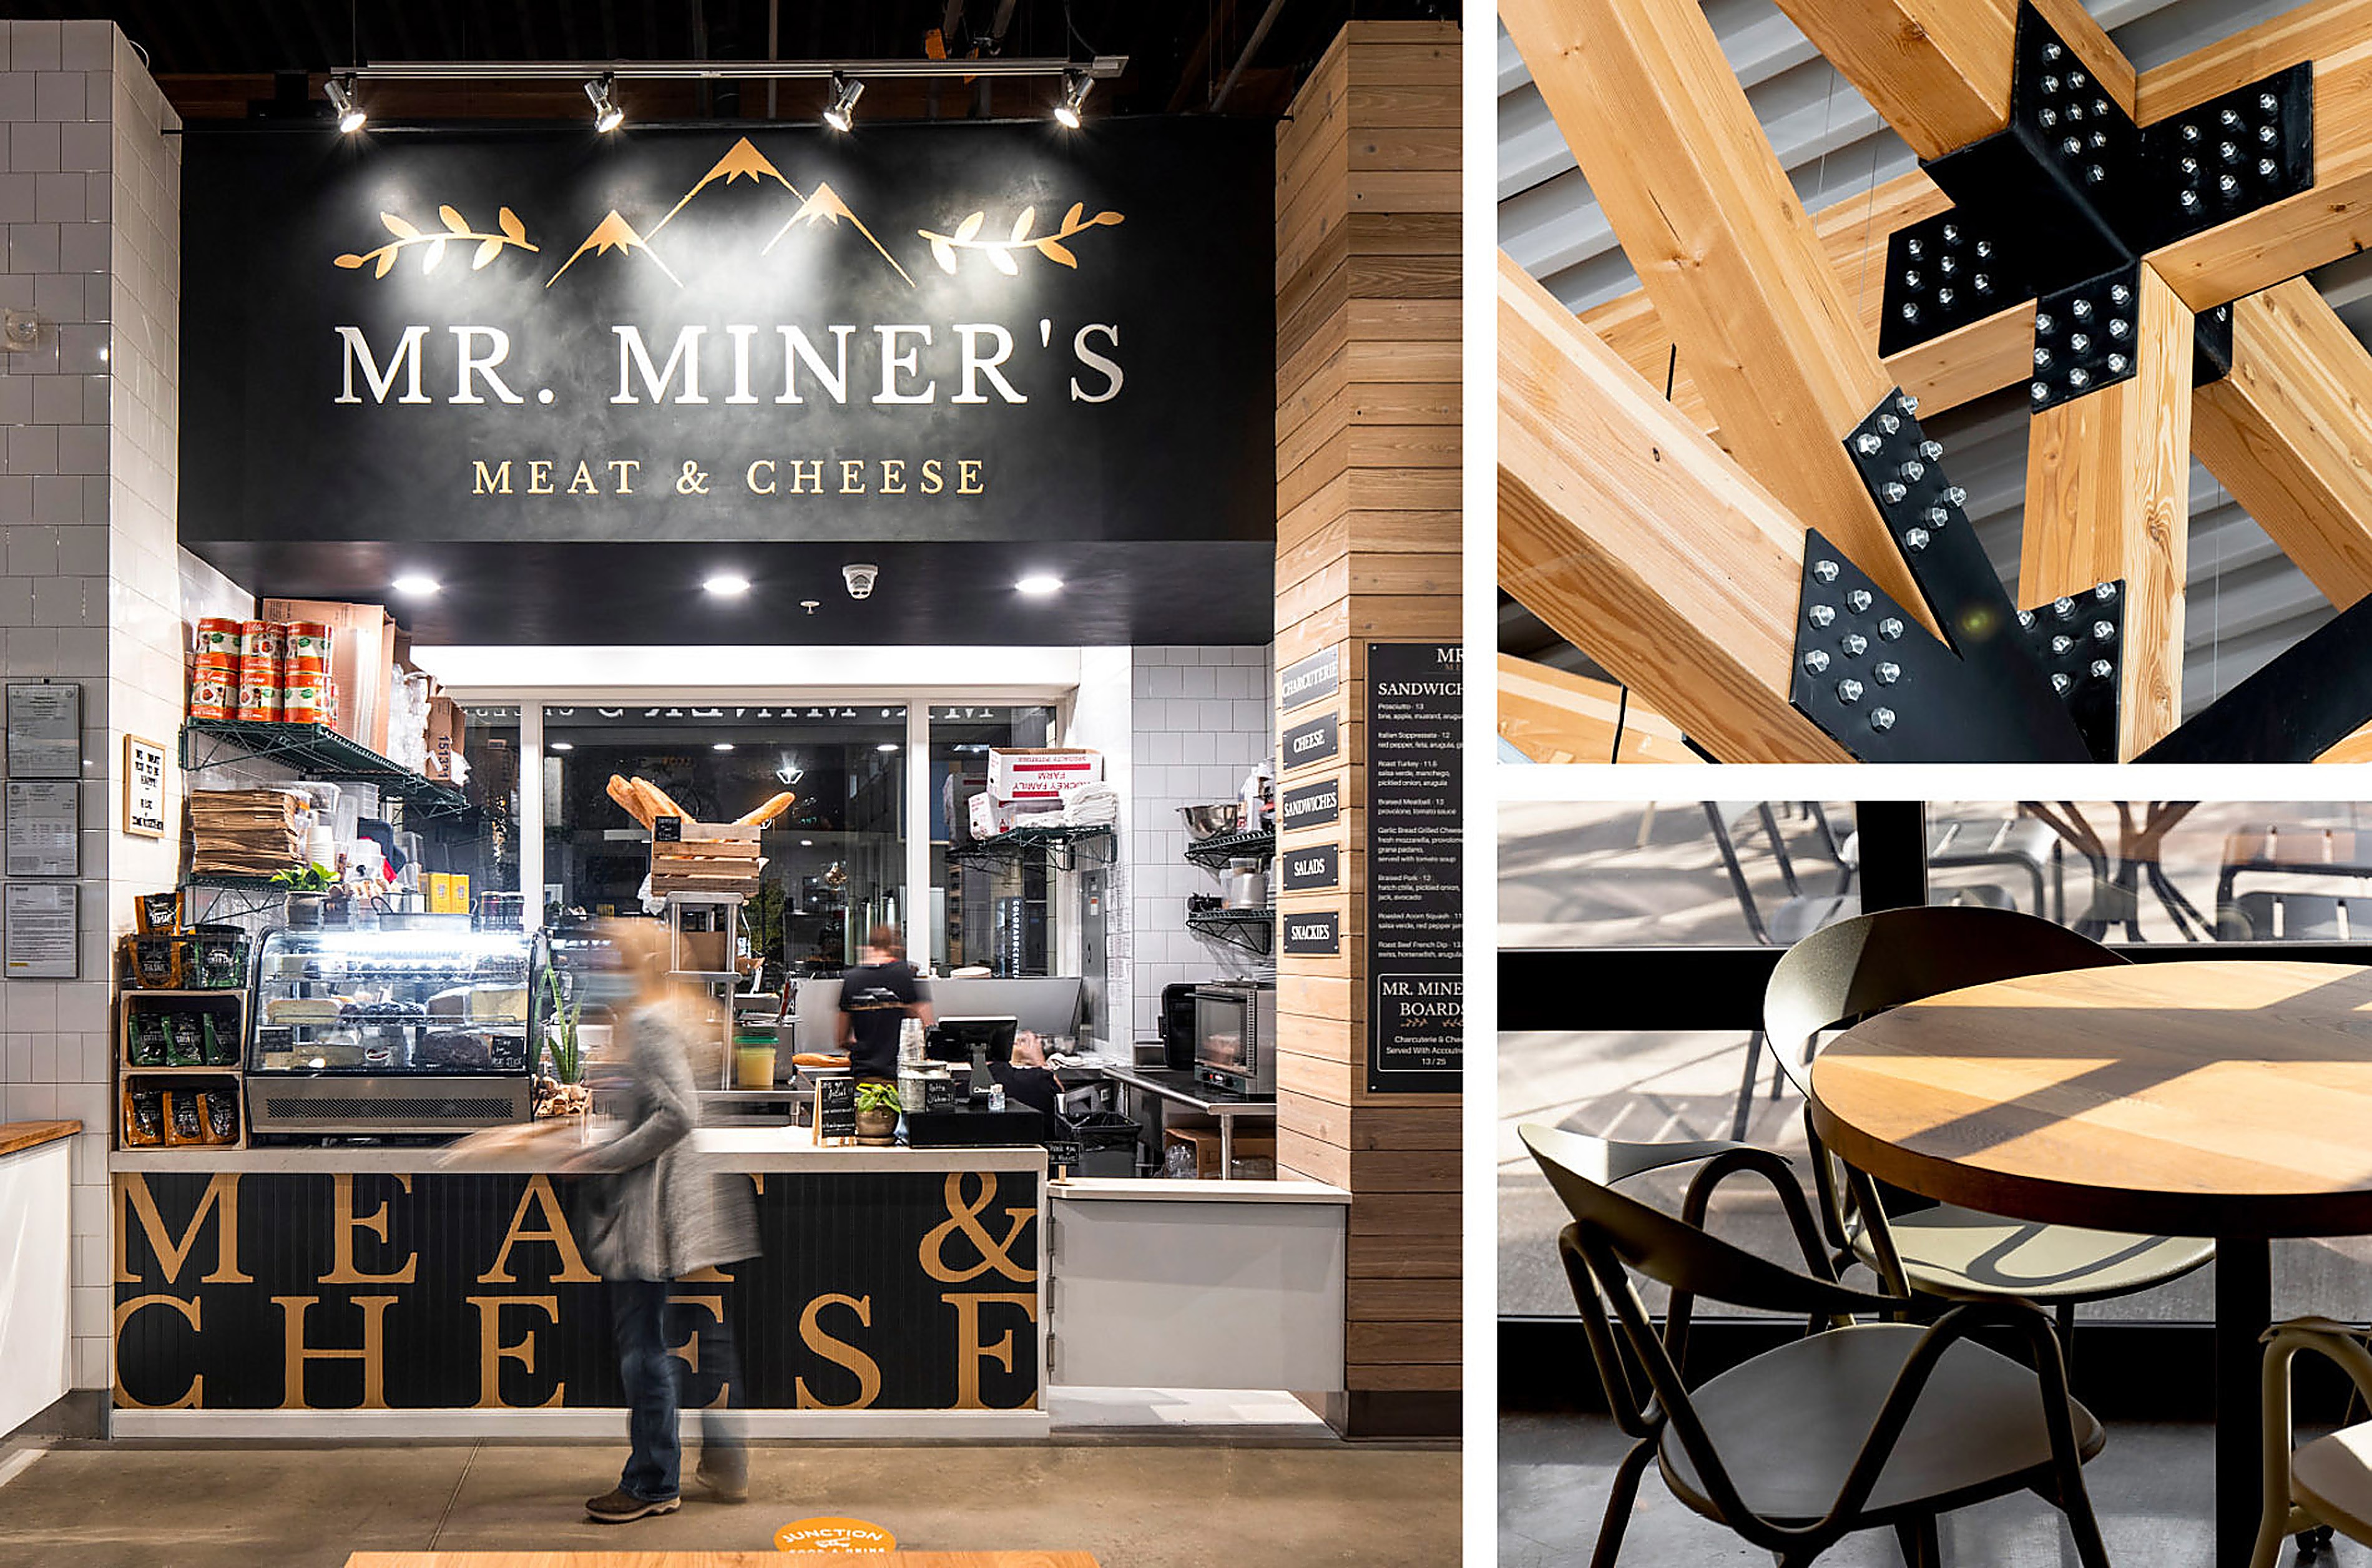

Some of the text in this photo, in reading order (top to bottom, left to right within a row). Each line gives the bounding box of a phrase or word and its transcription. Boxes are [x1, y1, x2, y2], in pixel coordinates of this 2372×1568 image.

[334, 318, 1124, 404] MR. MINER'S
[471, 459, 984, 494] MEAT & CHEESE
[1282, 663, 1338, 698] CHARCUTERIE
[1293, 728, 1325, 753] CHEESE
[1012, 781, 1047, 790] FAMILY
[1037, 772, 1066, 780] FARM
[1284, 791, 1338, 818] SANDWICHES
[1293, 858, 1325, 877] SALADS
[1291, 924, 1330, 941] SNACKIES
[1382, 982, 1413, 996] MR.
[115, 1172, 1037, 1283] MEA &
[782, 1528, 883, 1543] JUNCTION
